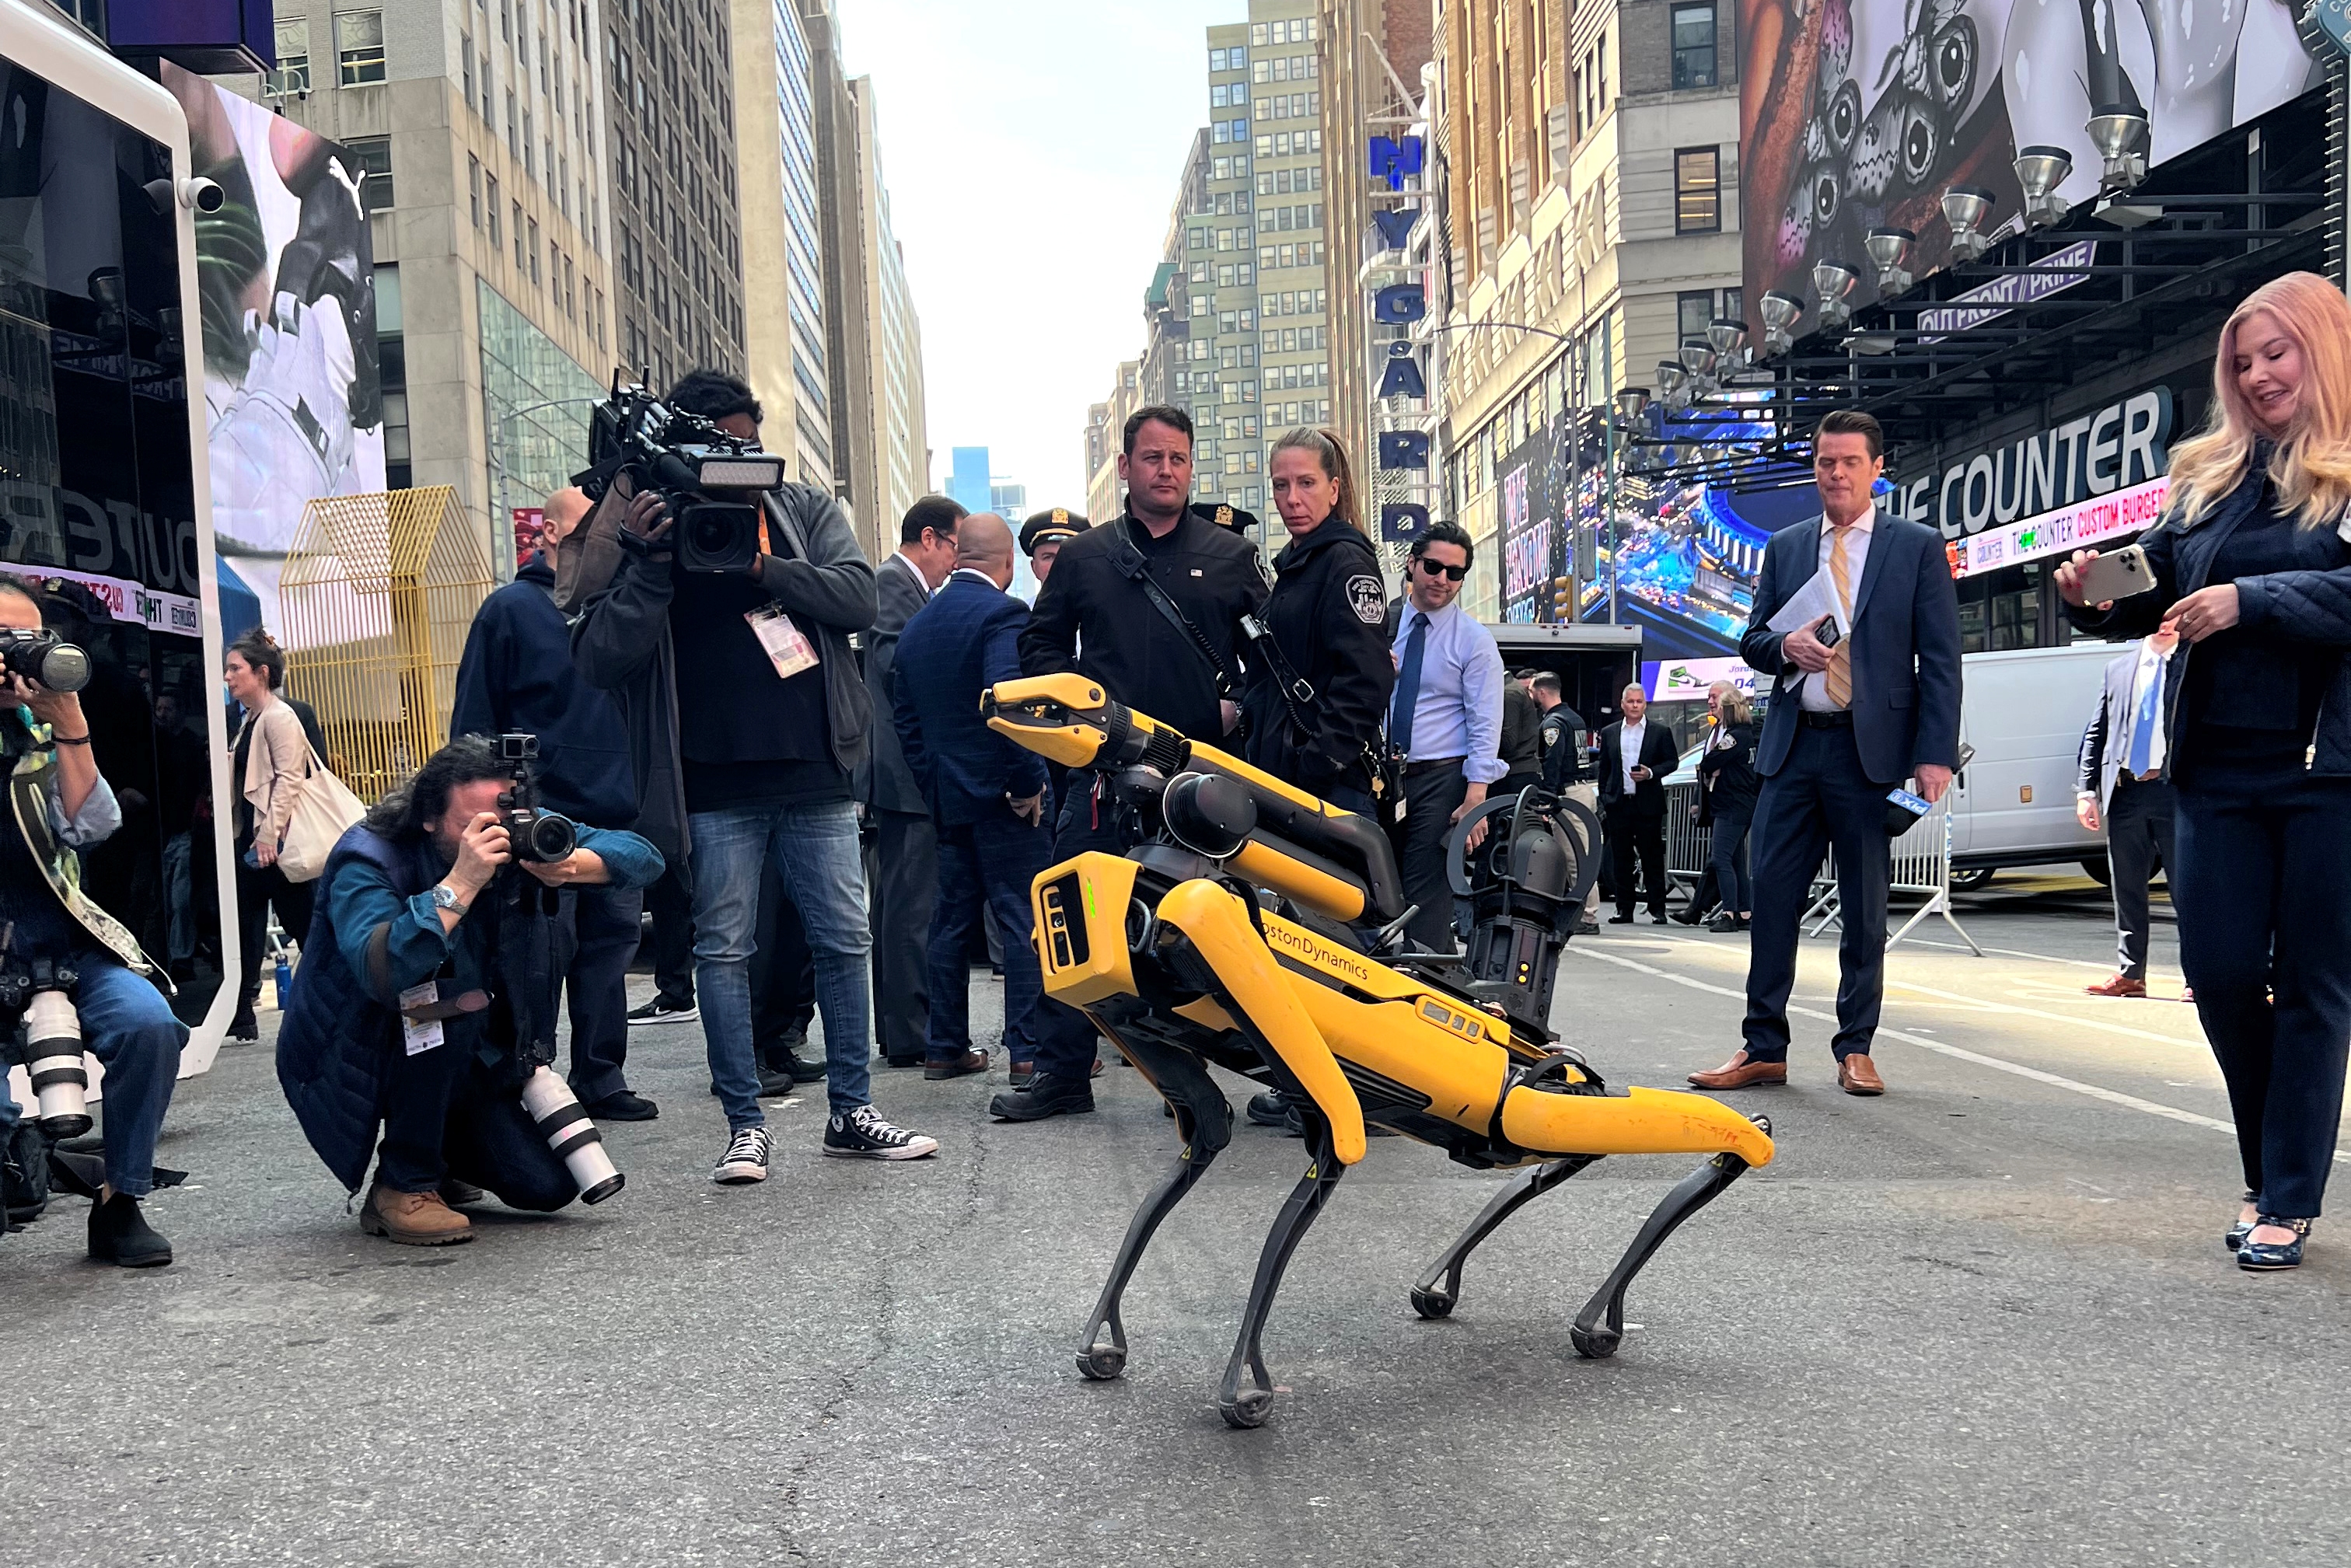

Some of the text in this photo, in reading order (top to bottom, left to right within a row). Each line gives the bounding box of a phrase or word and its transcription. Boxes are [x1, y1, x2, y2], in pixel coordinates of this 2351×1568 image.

[1504, 463, 1529, 534] WE
[1939, 391, 2161, 540] COUNTER
[1505, 517, 1551, 600] KNOW
[2031, 515, 2073, 550] COUNTER
[2077, 500, 2119, 538] CUSTOM
[1901, 797, 1928, 815] PIX
